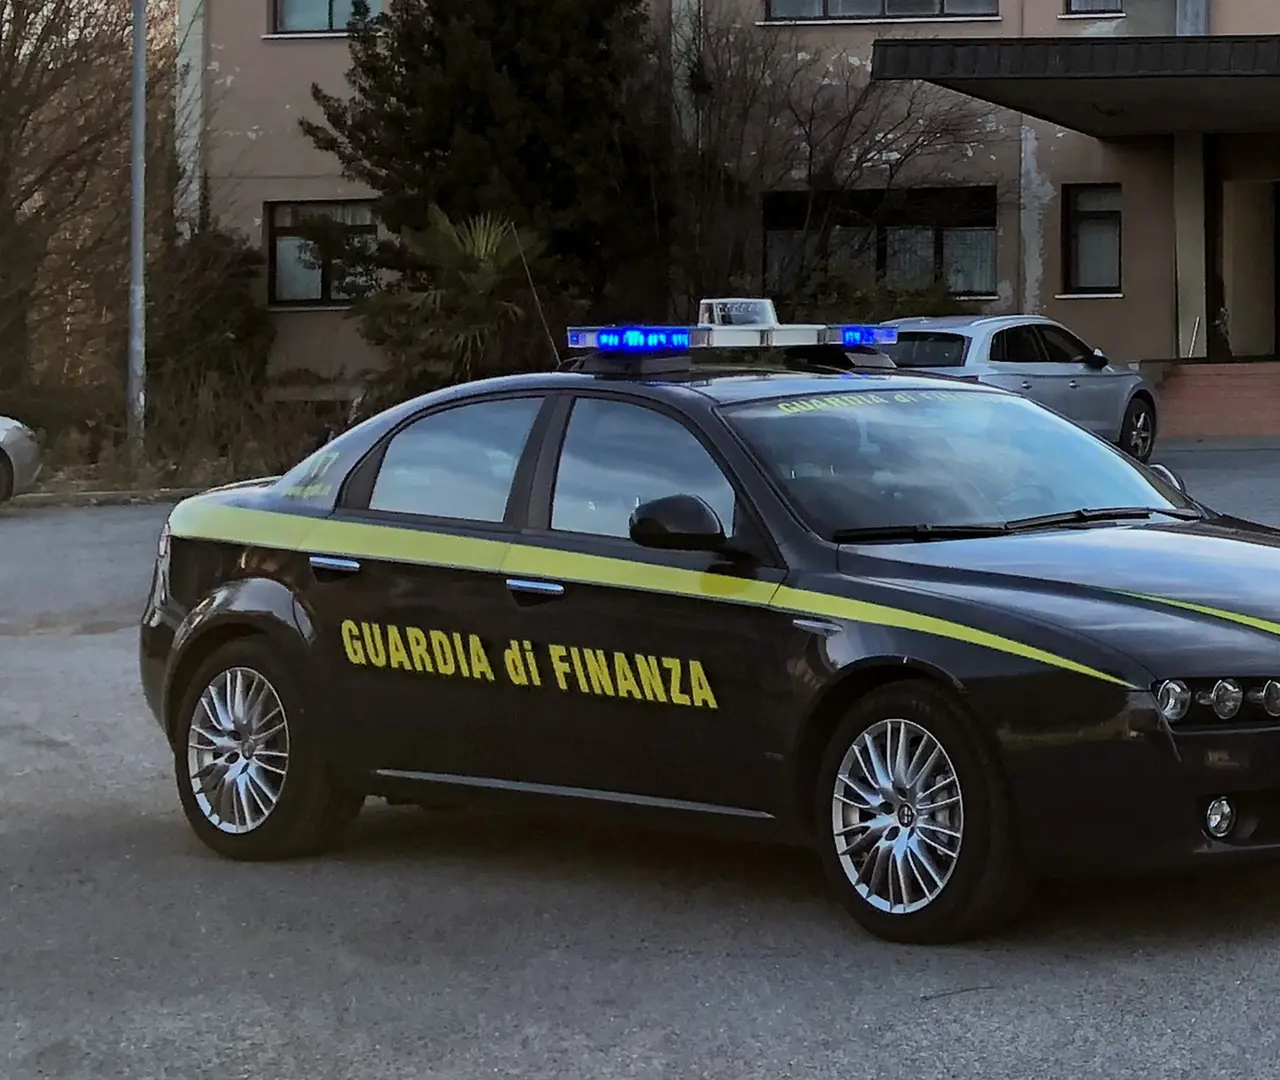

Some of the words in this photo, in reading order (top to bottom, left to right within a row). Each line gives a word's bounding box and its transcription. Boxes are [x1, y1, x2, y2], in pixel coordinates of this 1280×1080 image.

[778, 392, 888, 415] GUARDIA
[341, 619, 495, 681] GUARDIA
[504, 640, 541, 686] di
[548, 644, 718, 709] FINANZA
